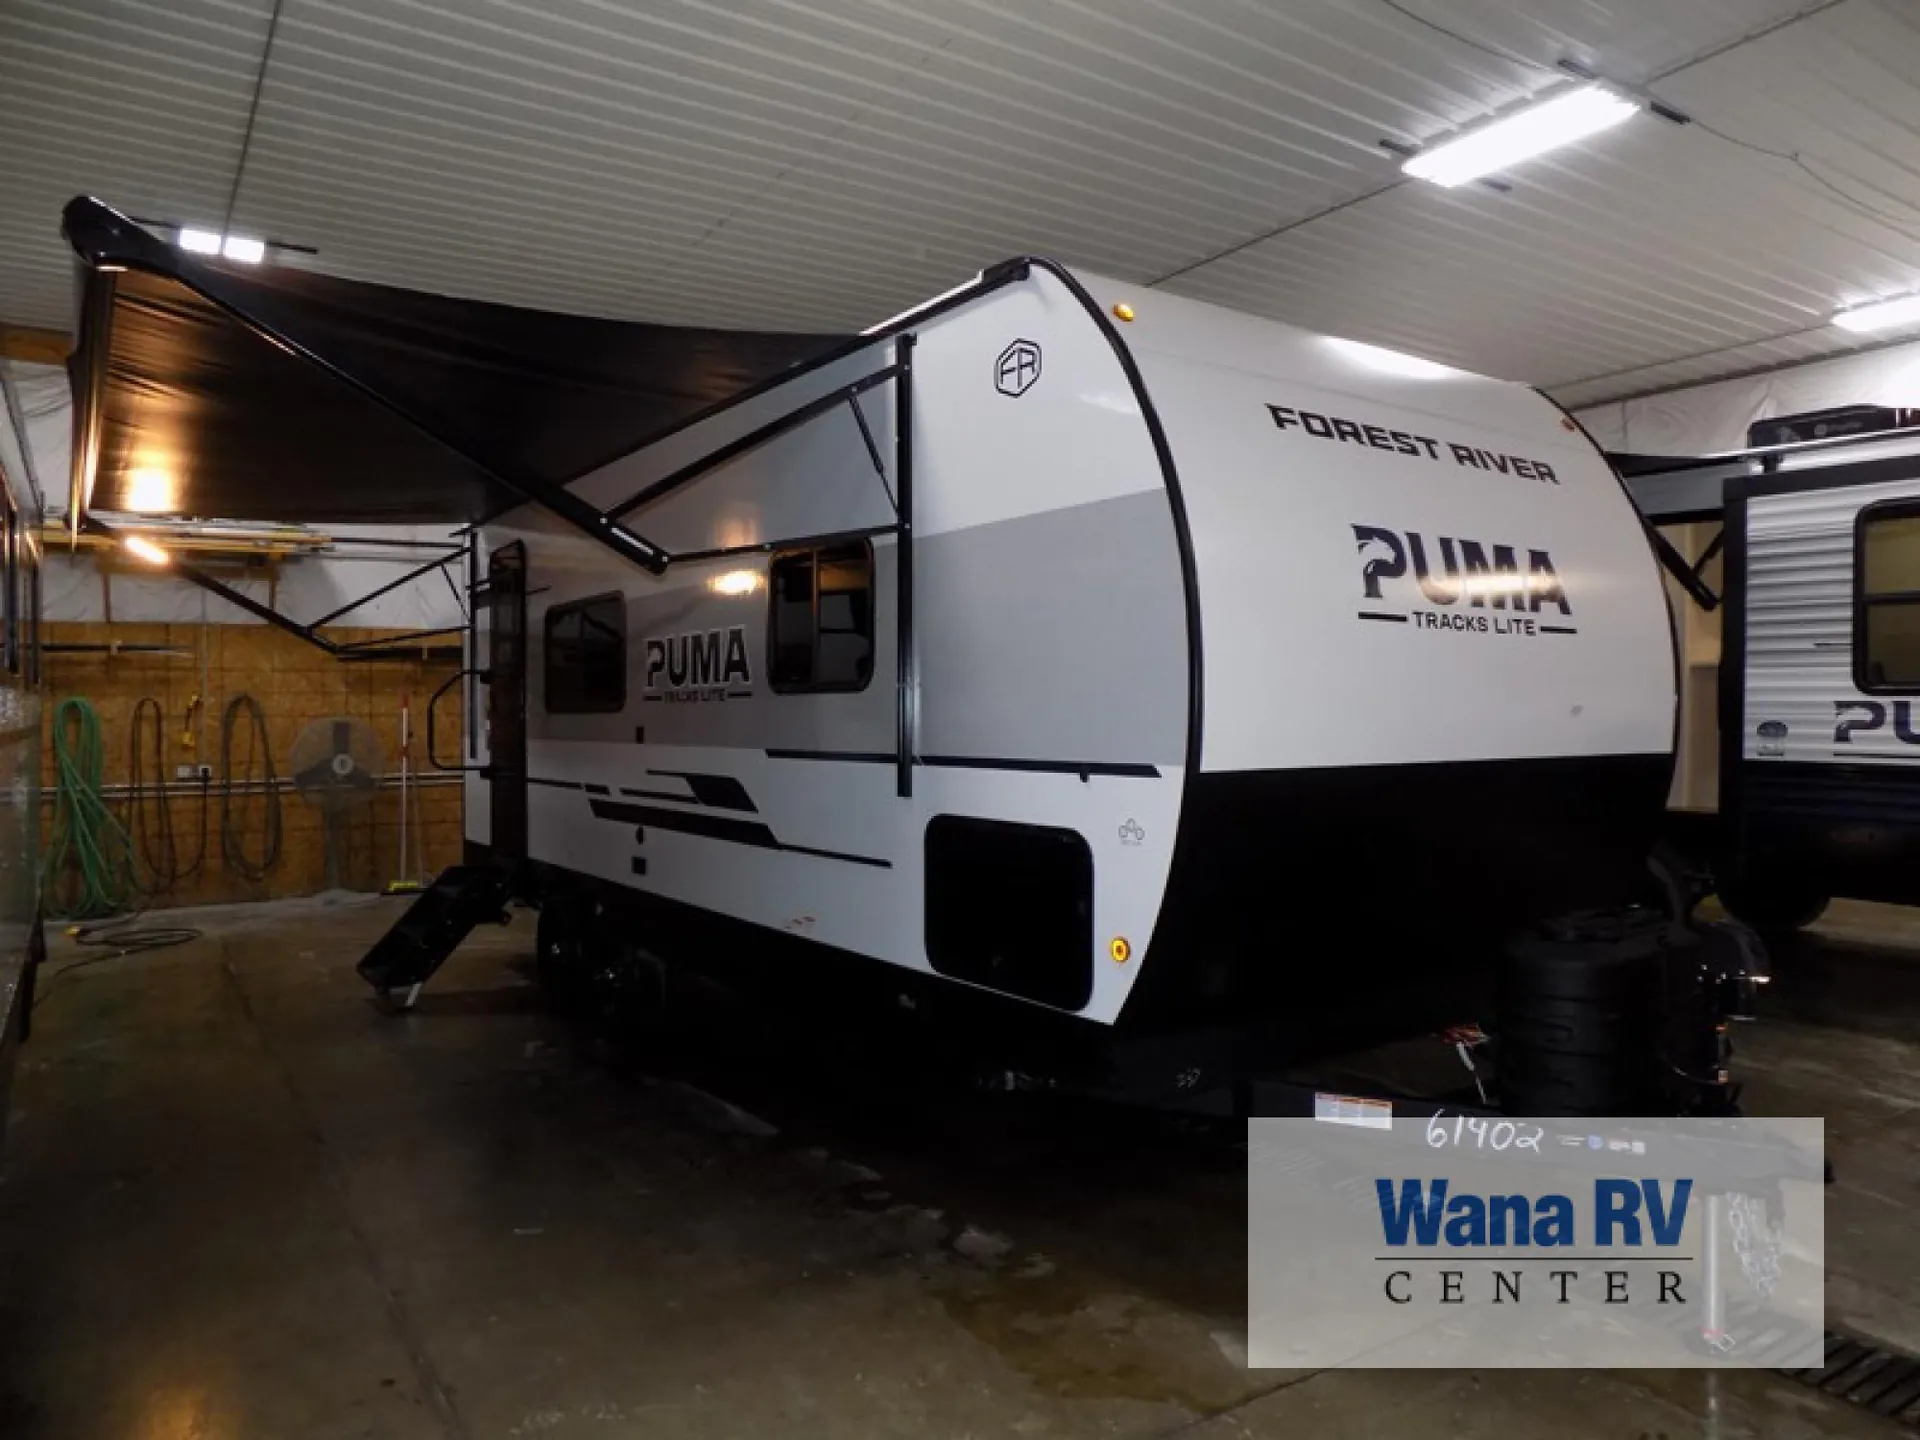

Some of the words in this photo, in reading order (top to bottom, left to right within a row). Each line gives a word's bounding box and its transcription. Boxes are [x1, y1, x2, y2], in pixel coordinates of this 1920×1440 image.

[1265, 402, 1438, 460] FOREST
[1447, 442, 1561, 484] RIVER
[1351, 523, 1572, 616] PUMA
[1412, 611, 1489, 632] TRACKS
[1494, 617, 1537, 636] LITE
[644, 625, 751, 688] PUMA
[1427, 1107, 1544, 1153] 61402
